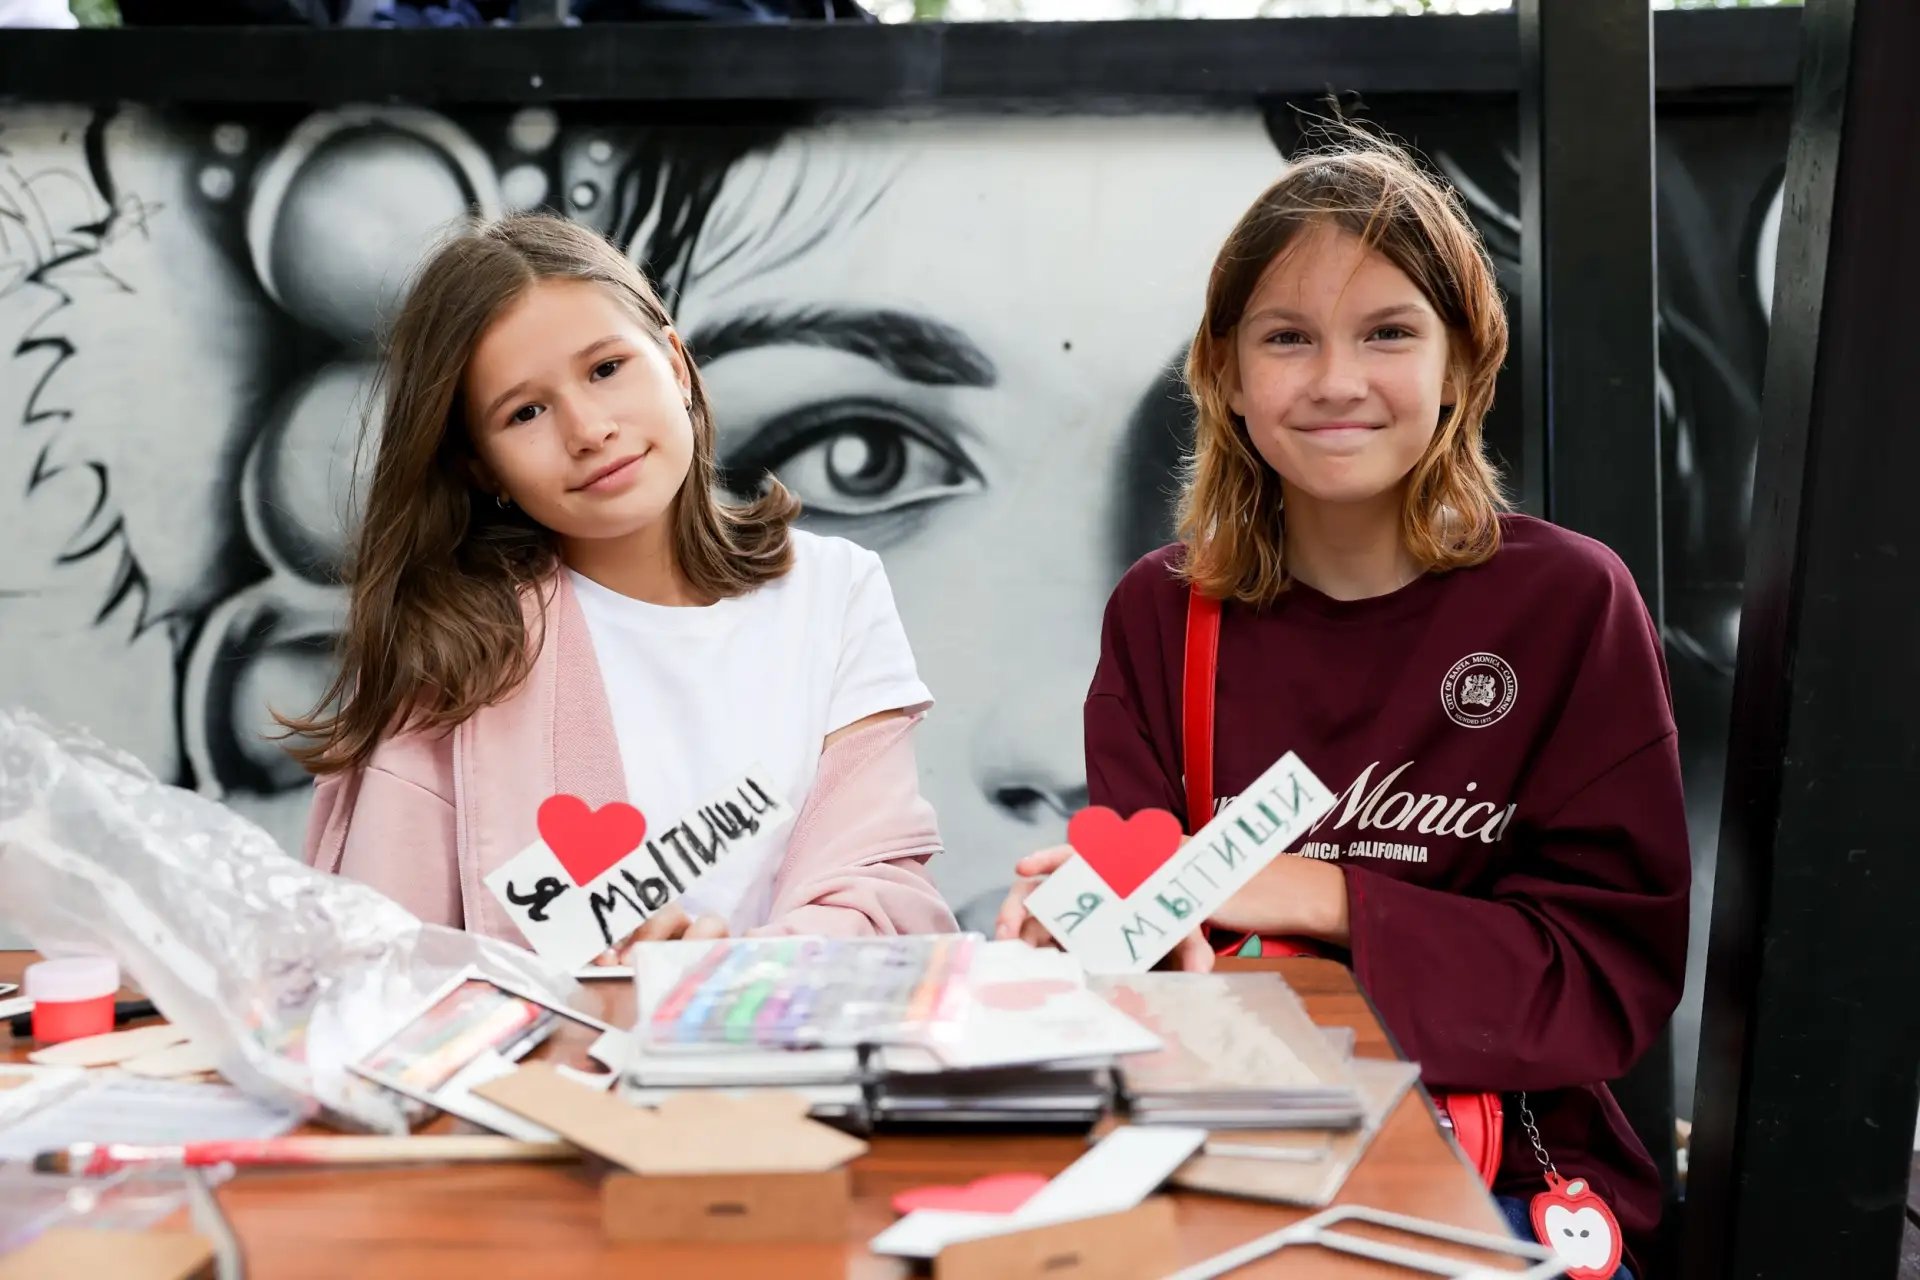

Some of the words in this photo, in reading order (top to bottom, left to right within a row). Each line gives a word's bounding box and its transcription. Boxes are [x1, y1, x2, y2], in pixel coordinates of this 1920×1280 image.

[1449, 660, 1470, 680] SANTA
[1472, 655, 1500, 668] MONICA
[1445, 680, 1452, 691] OF
[1496, 669, 1514, 714] CALIFORNIA
[1445, 693, 1455, 710] CITY
[1454, 713, 1479, 725] FOUNDED
[1308, 760, 1517, 844] Monica
[1285, 842, 1340, 860] NICA
[1348, 841, 1428, 863] CALIFORNIA
